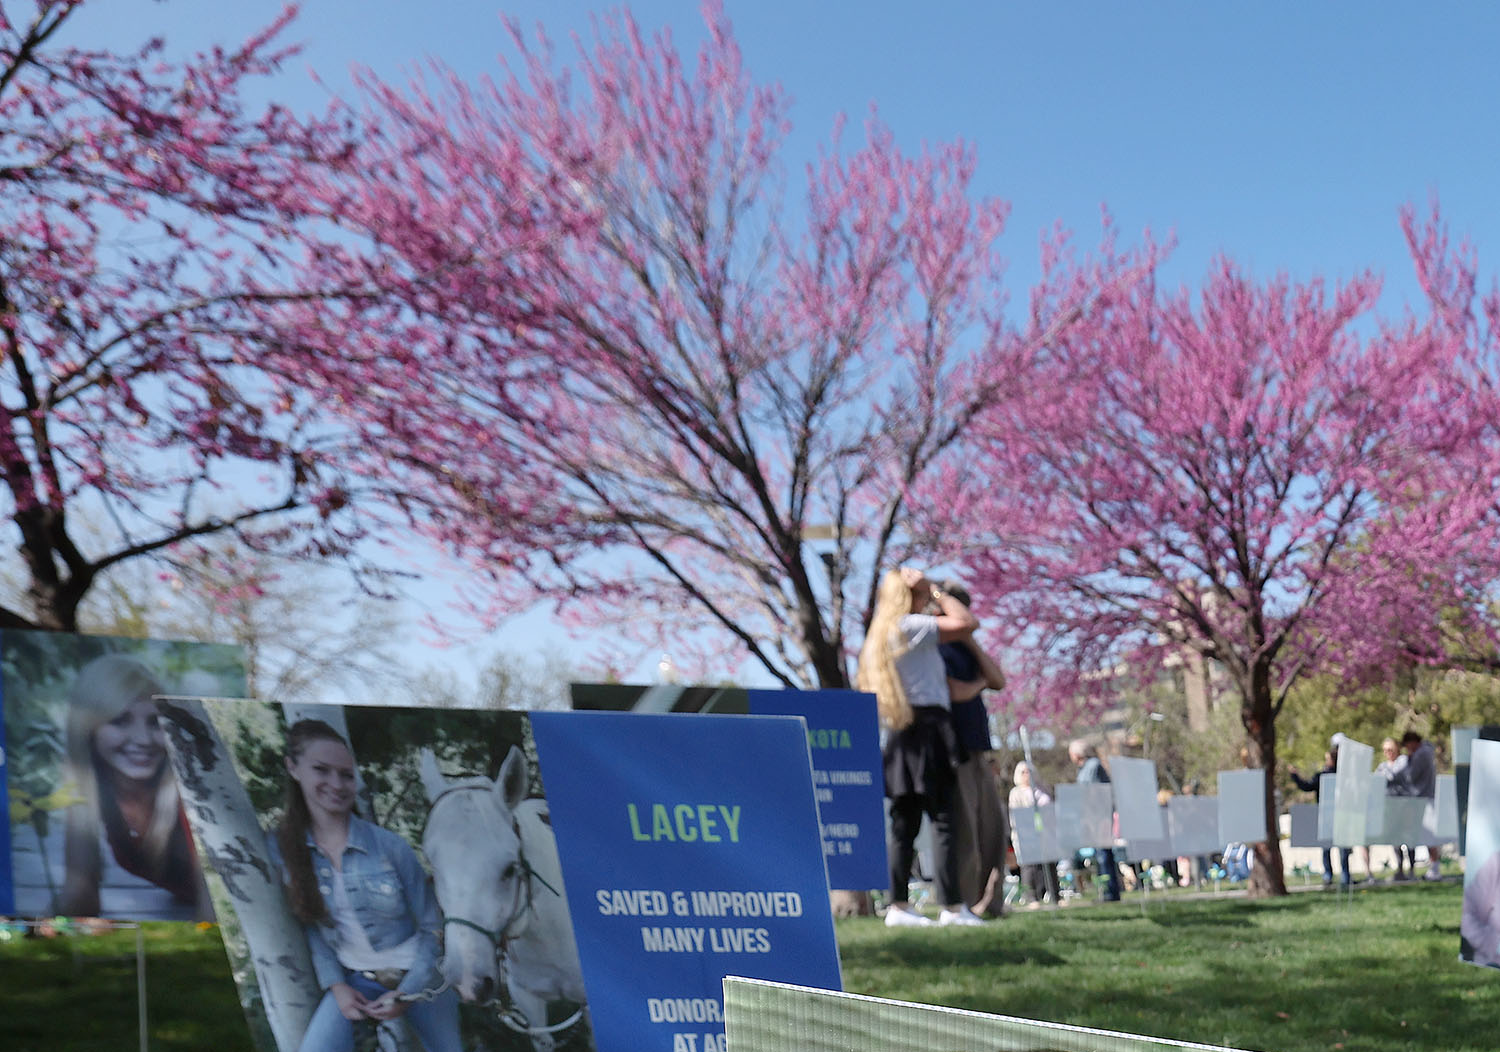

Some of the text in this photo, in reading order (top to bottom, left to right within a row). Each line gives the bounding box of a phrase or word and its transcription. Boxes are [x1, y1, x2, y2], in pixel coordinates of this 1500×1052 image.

[627, 803, 741, 843] LACEY
[821, 823, 859, 838] /HERO
[596, 890, 802, 917] SAVED & IMPROVED
[641, 927, 771, 953] MANY LIVES
